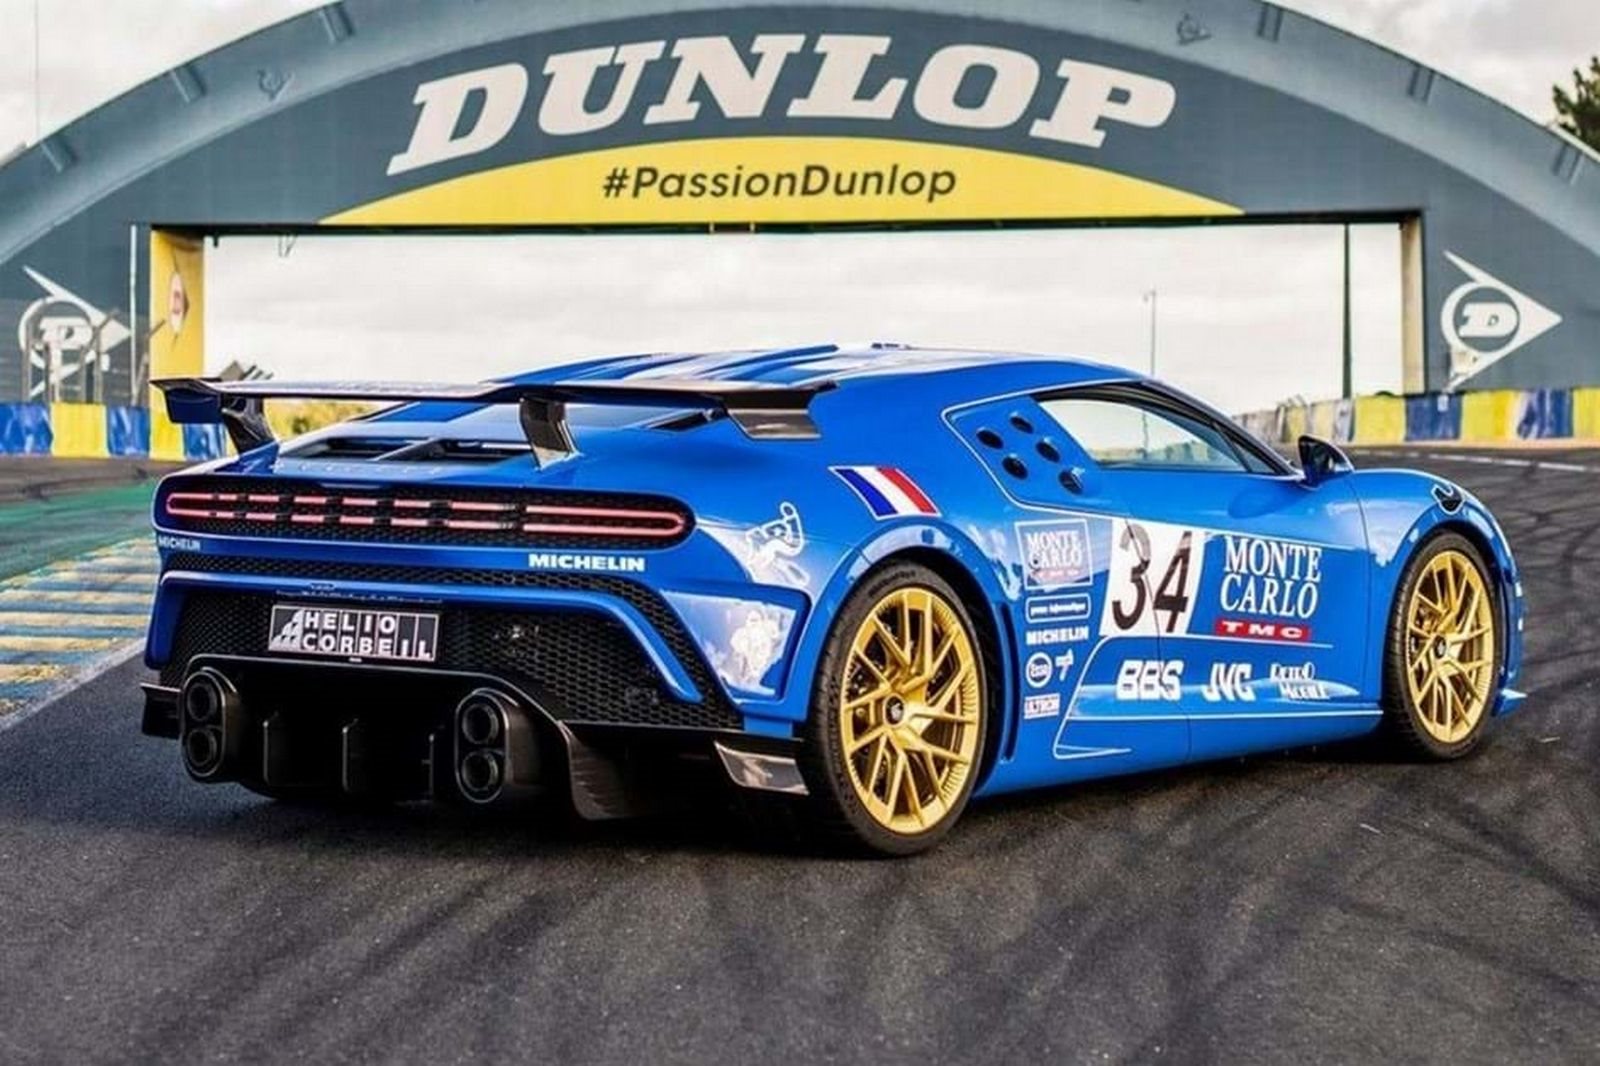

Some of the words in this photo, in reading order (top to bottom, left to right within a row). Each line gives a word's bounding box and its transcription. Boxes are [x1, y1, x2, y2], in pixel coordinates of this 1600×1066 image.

[386, 33, 1177, 176] DUNLOP
[602, 164, 957, 201] #PassionDunlop
[1024, 529, 1081, 551] MONTE
[528, 552, 646, 573] MICHELIN
[1111, 522, 1193, 633] 34
[1223, 534, 1323, 584] MONTE
[1219, 573, 1319, 619] CARLO
[304, 610, 396, 634] HELIO
[1026, 625, 1090, 645] MICHELIN
[1220, 620, 1304, 639] TMC
[302, 632, 431, 659] CORBEIL
[1116, 659, 1184, 701] BBS
[1202, 662, 1257, 702] JVC
